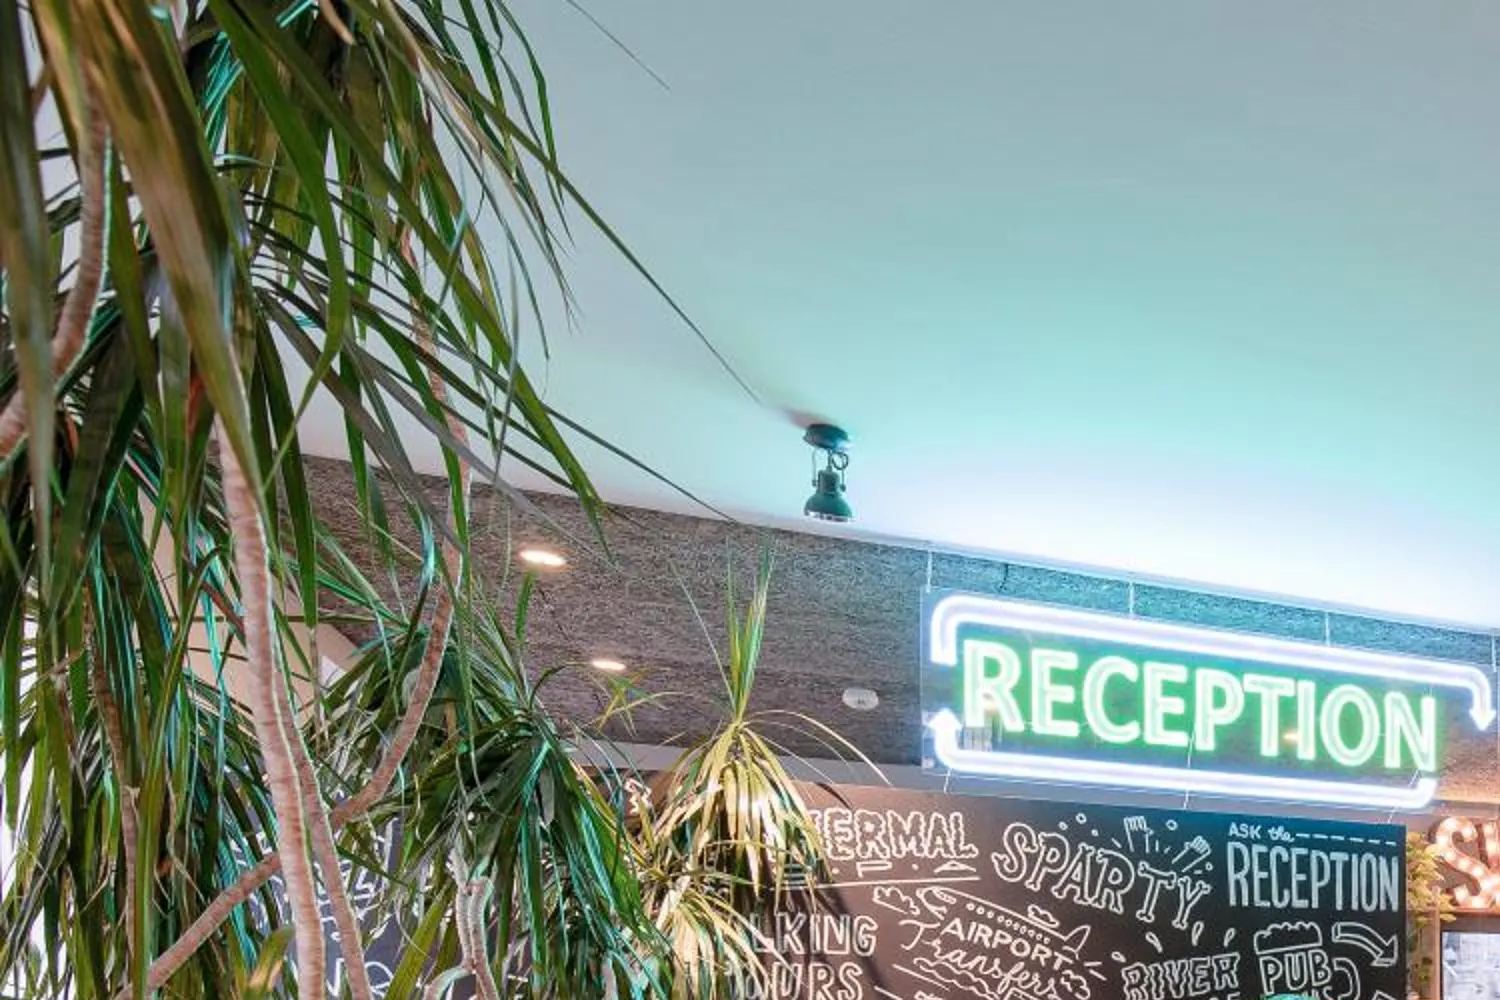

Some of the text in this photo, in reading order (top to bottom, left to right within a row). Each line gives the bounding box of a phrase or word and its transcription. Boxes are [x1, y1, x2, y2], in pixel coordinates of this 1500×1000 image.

[962, 638, 1437, 773] RECEPTION
[808, 808, 979, 861] ERMAL
[1228, 822, 1296, 843] ASK the
[991, 822, 1210, 929] SPARTY
[1226, 841, 1399, 913] RECEPTION
[751, 911, 879, 957] LKING
[940, 917, 1074, 971] AIRPORT
[1259, 948, 1332, 996] PUB
